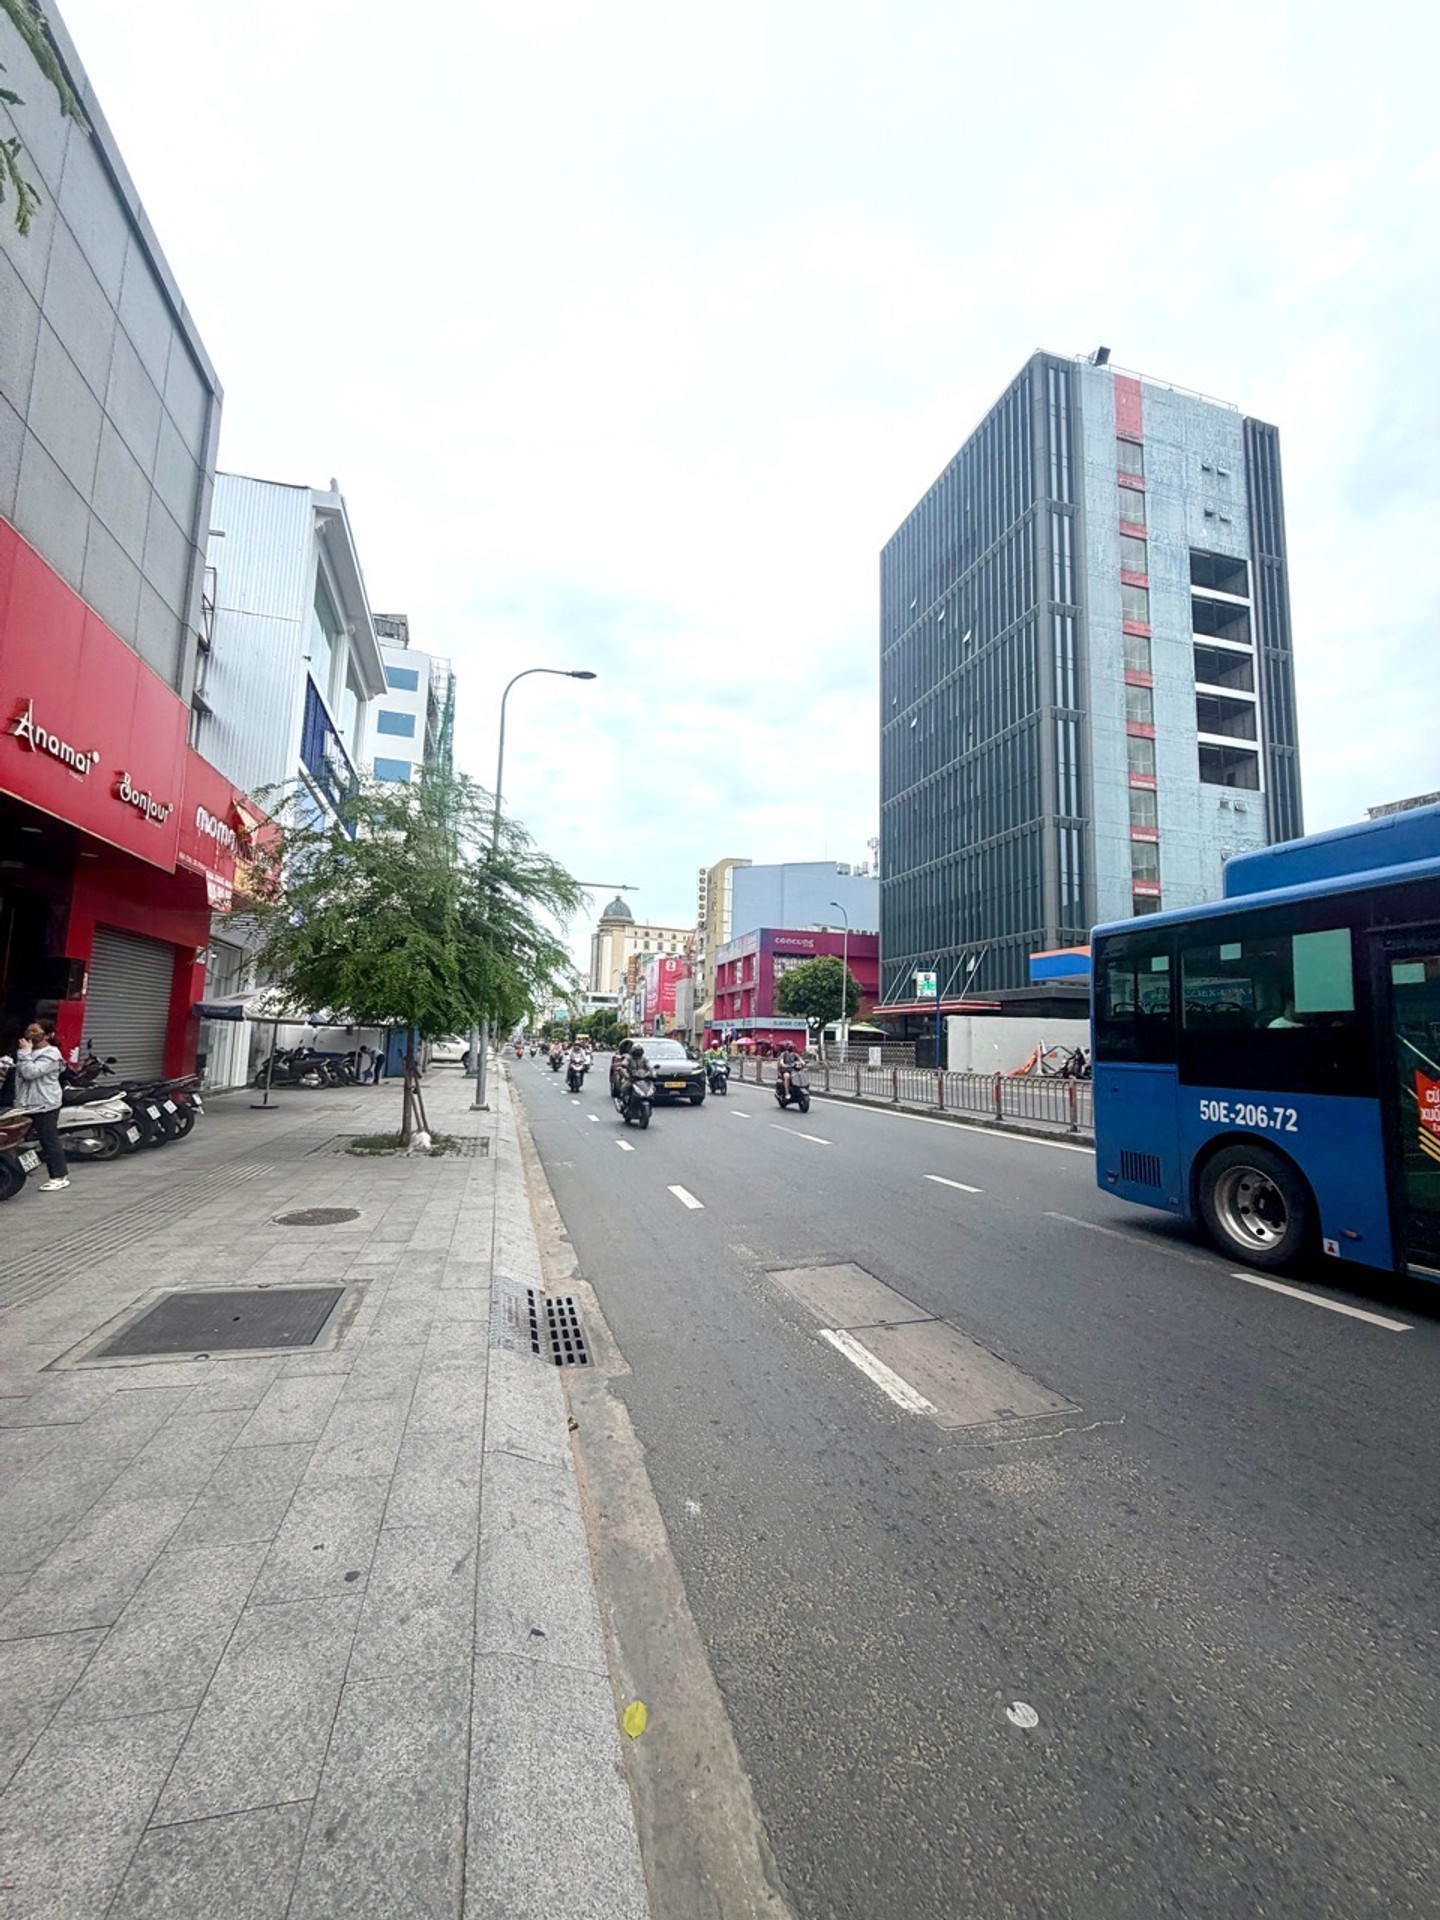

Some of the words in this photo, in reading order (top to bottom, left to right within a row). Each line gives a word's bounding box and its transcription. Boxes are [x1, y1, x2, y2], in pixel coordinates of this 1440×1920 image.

[14, 699, 93, 776] Anamai
[119, 772, 168, 823] Bonjour
[1200, 1099, 1298, 1132] 50E-206.72
